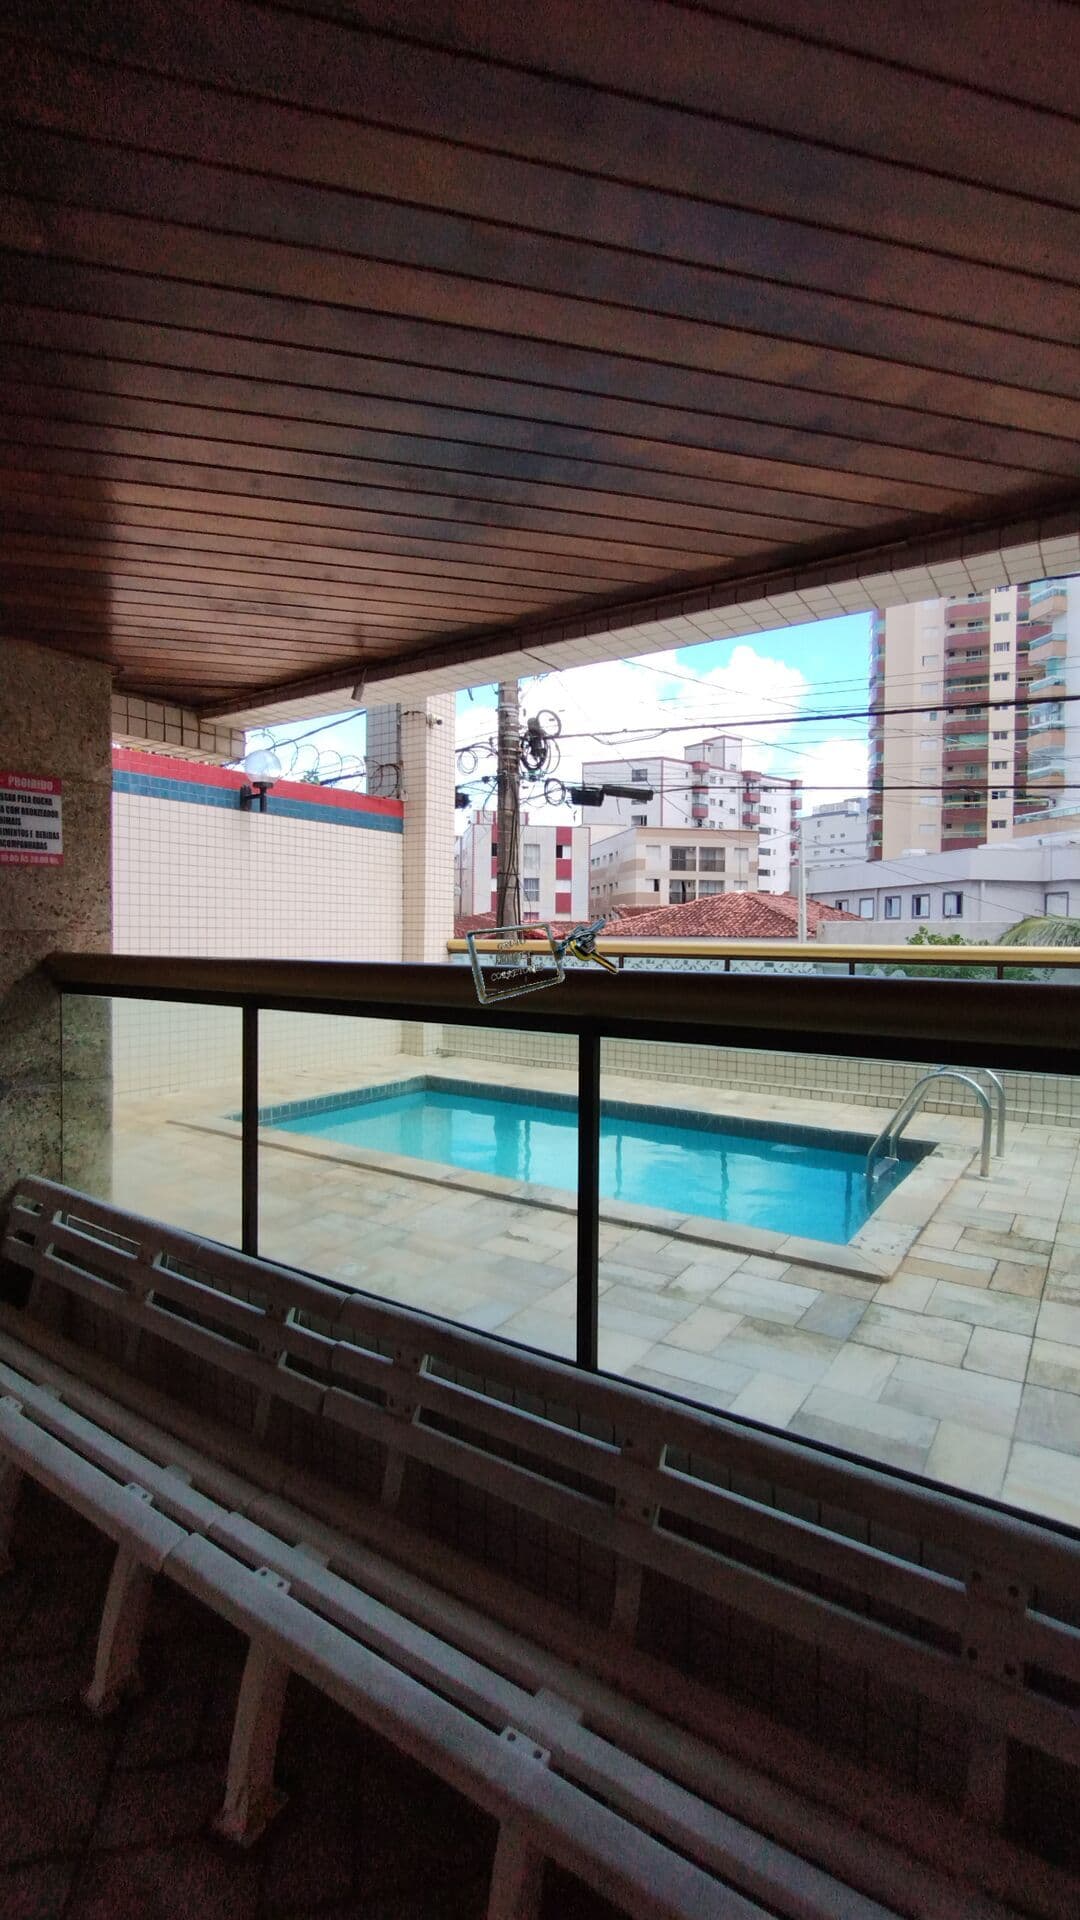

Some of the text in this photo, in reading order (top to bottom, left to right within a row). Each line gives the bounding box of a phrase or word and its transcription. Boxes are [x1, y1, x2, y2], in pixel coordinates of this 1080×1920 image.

[8, 775, 54, 791] PROIBIDO
[17, 794, 32, 803] PELA
[33, 796, 53, 806] DUCHA
[6, 805, 20, 815] COM
[35, 830, 60, 840] BEBIDAS
